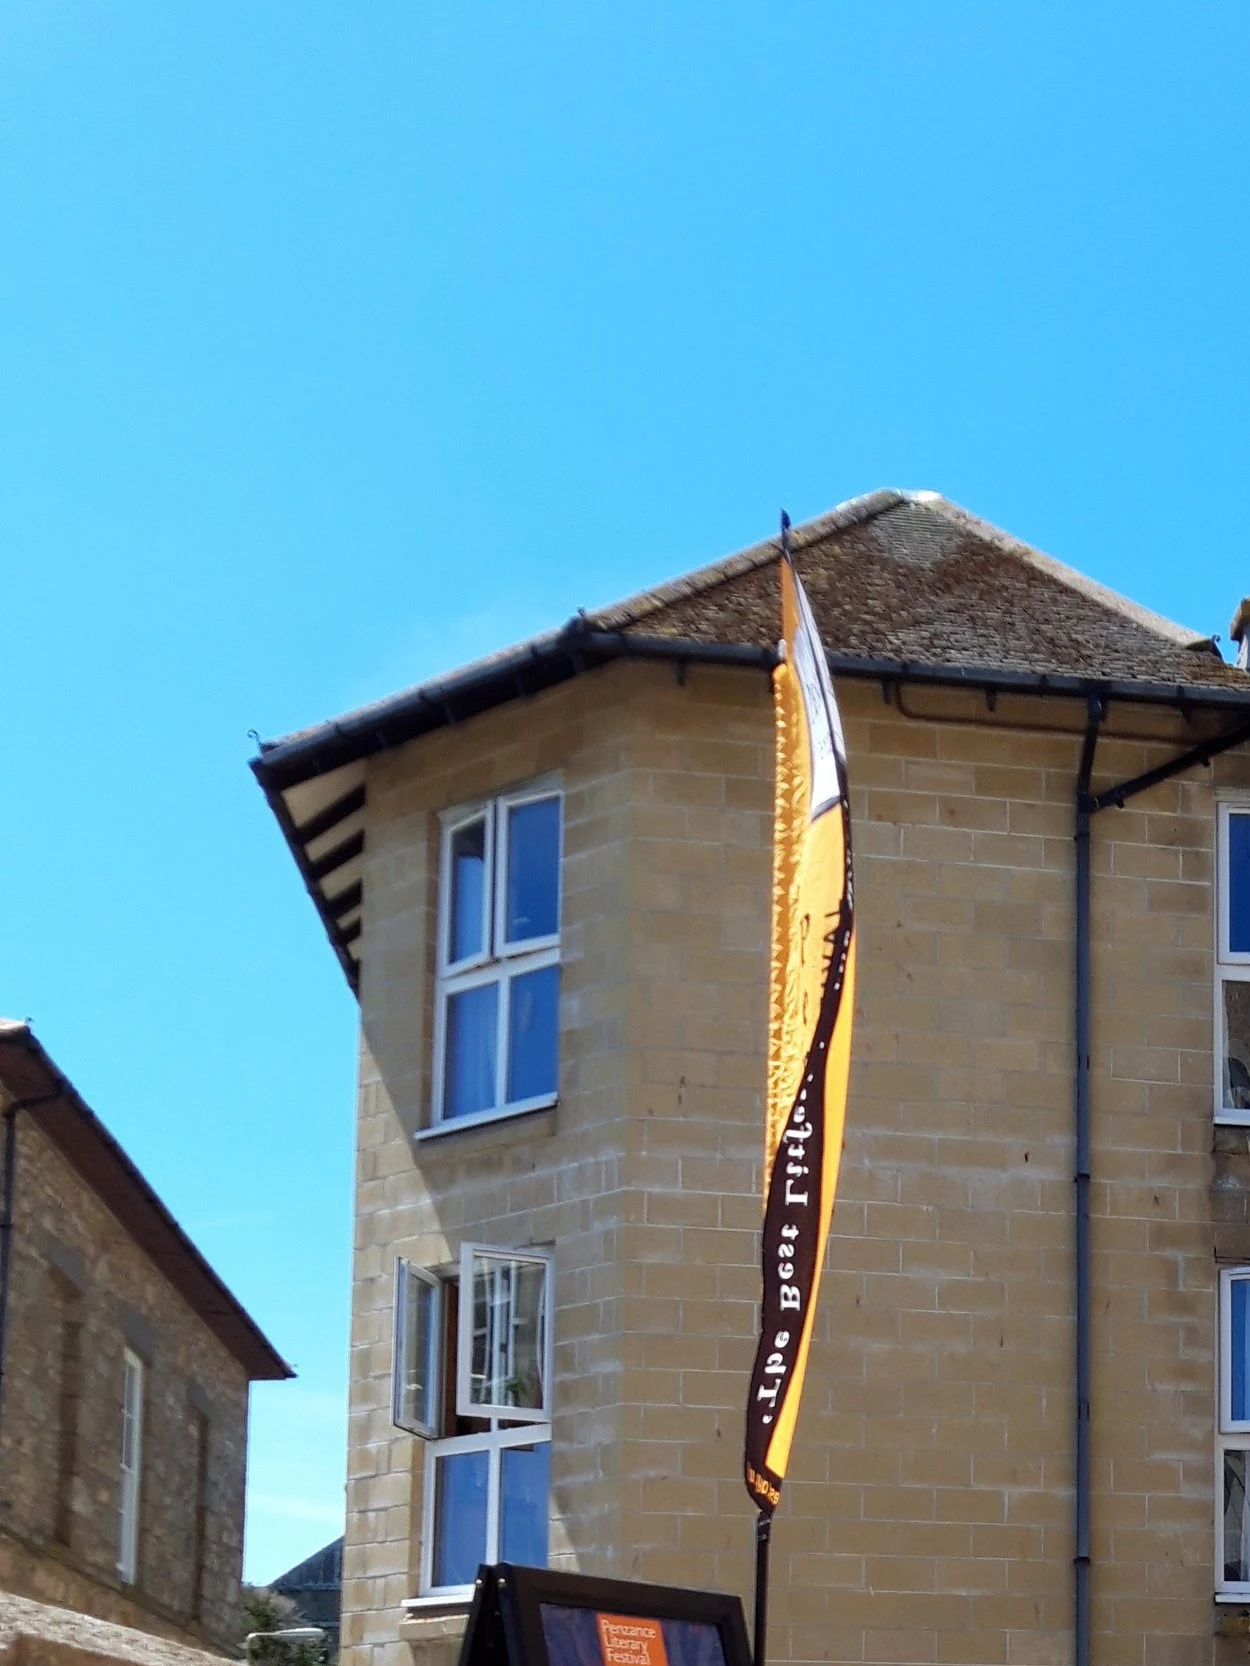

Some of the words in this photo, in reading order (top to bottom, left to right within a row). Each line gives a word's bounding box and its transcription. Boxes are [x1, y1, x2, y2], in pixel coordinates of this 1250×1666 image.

[600, 1619, 657, 1639] Penzance
[603, 1634, 648, 1656] Literary
[606, 1647, 651, 1666] Festival
